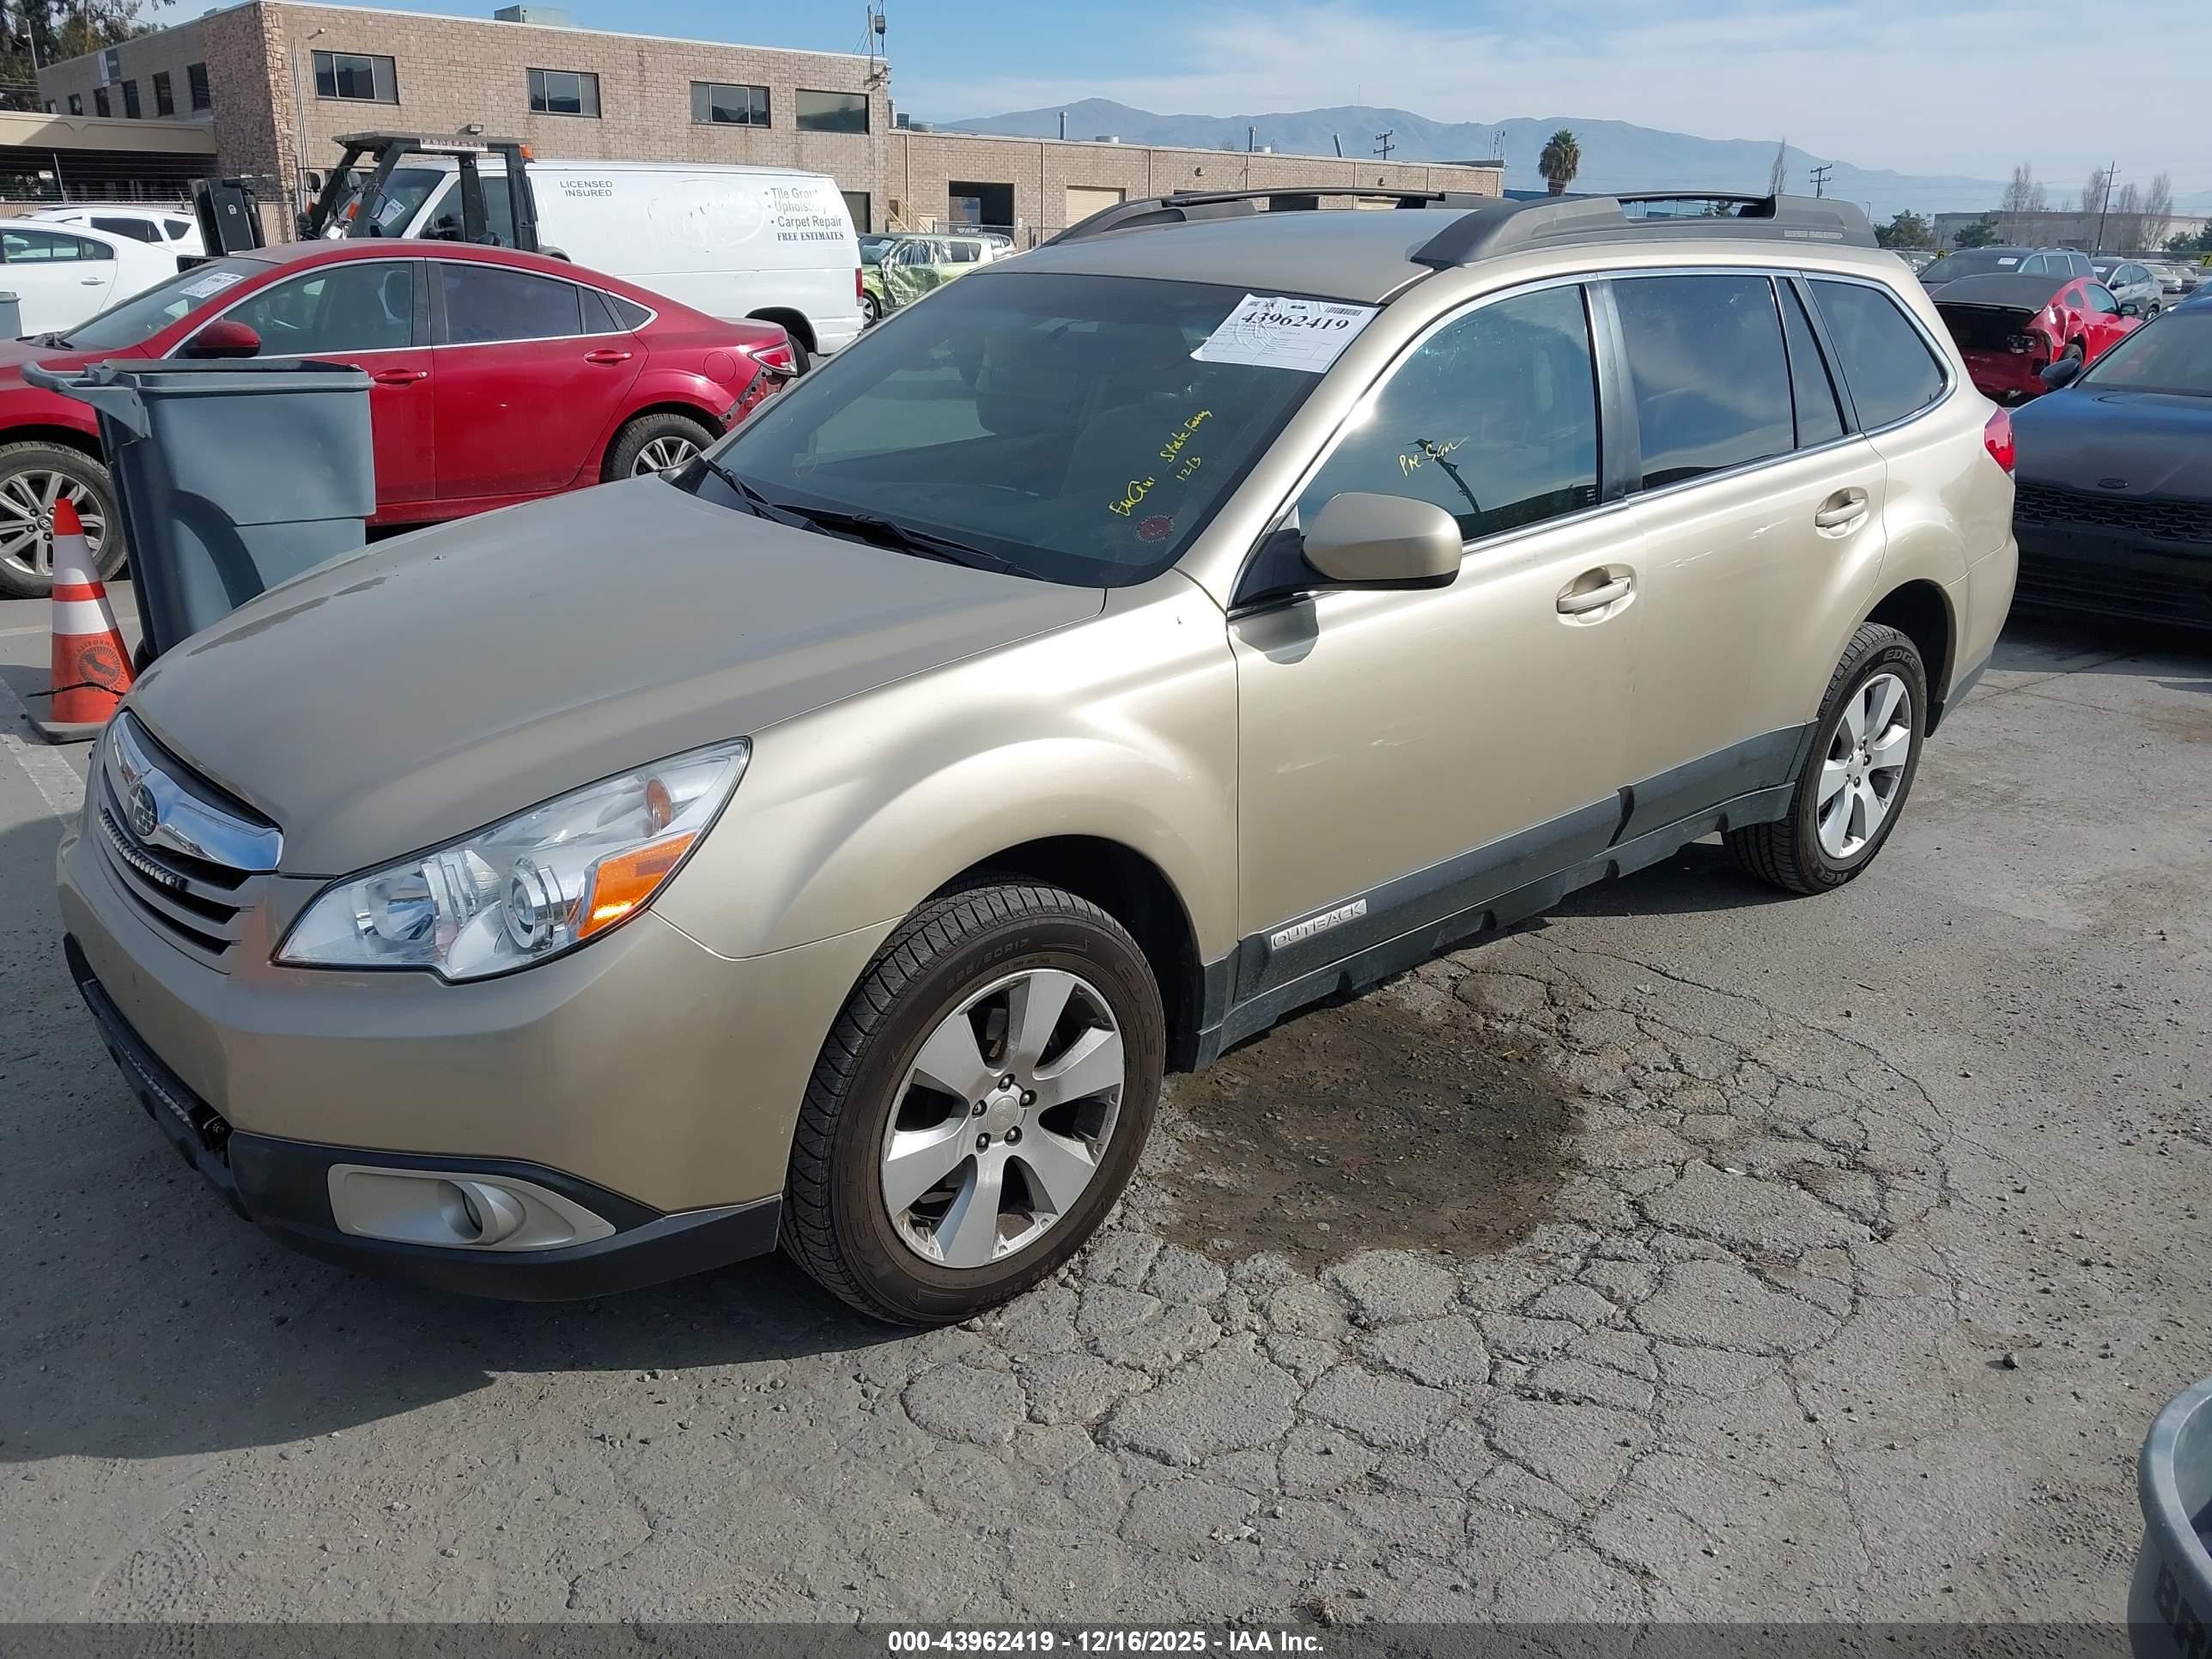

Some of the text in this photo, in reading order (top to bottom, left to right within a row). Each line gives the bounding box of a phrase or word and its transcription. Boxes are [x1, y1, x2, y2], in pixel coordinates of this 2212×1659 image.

[560, 180, 613, 189] LICENSED
[769, 187, 790, 199] Tile
[774, 199, 827, 216] Upholst
[777, 214, 842, 230] Carpet Repair
[776, 231, 844, 241] FREE ESTIMATES
[1241, 311, 1350, 331] 43962419
[1883, 648, 1918, 671] EDGE
[1272, 900, 1364, 949] OUTBACK
